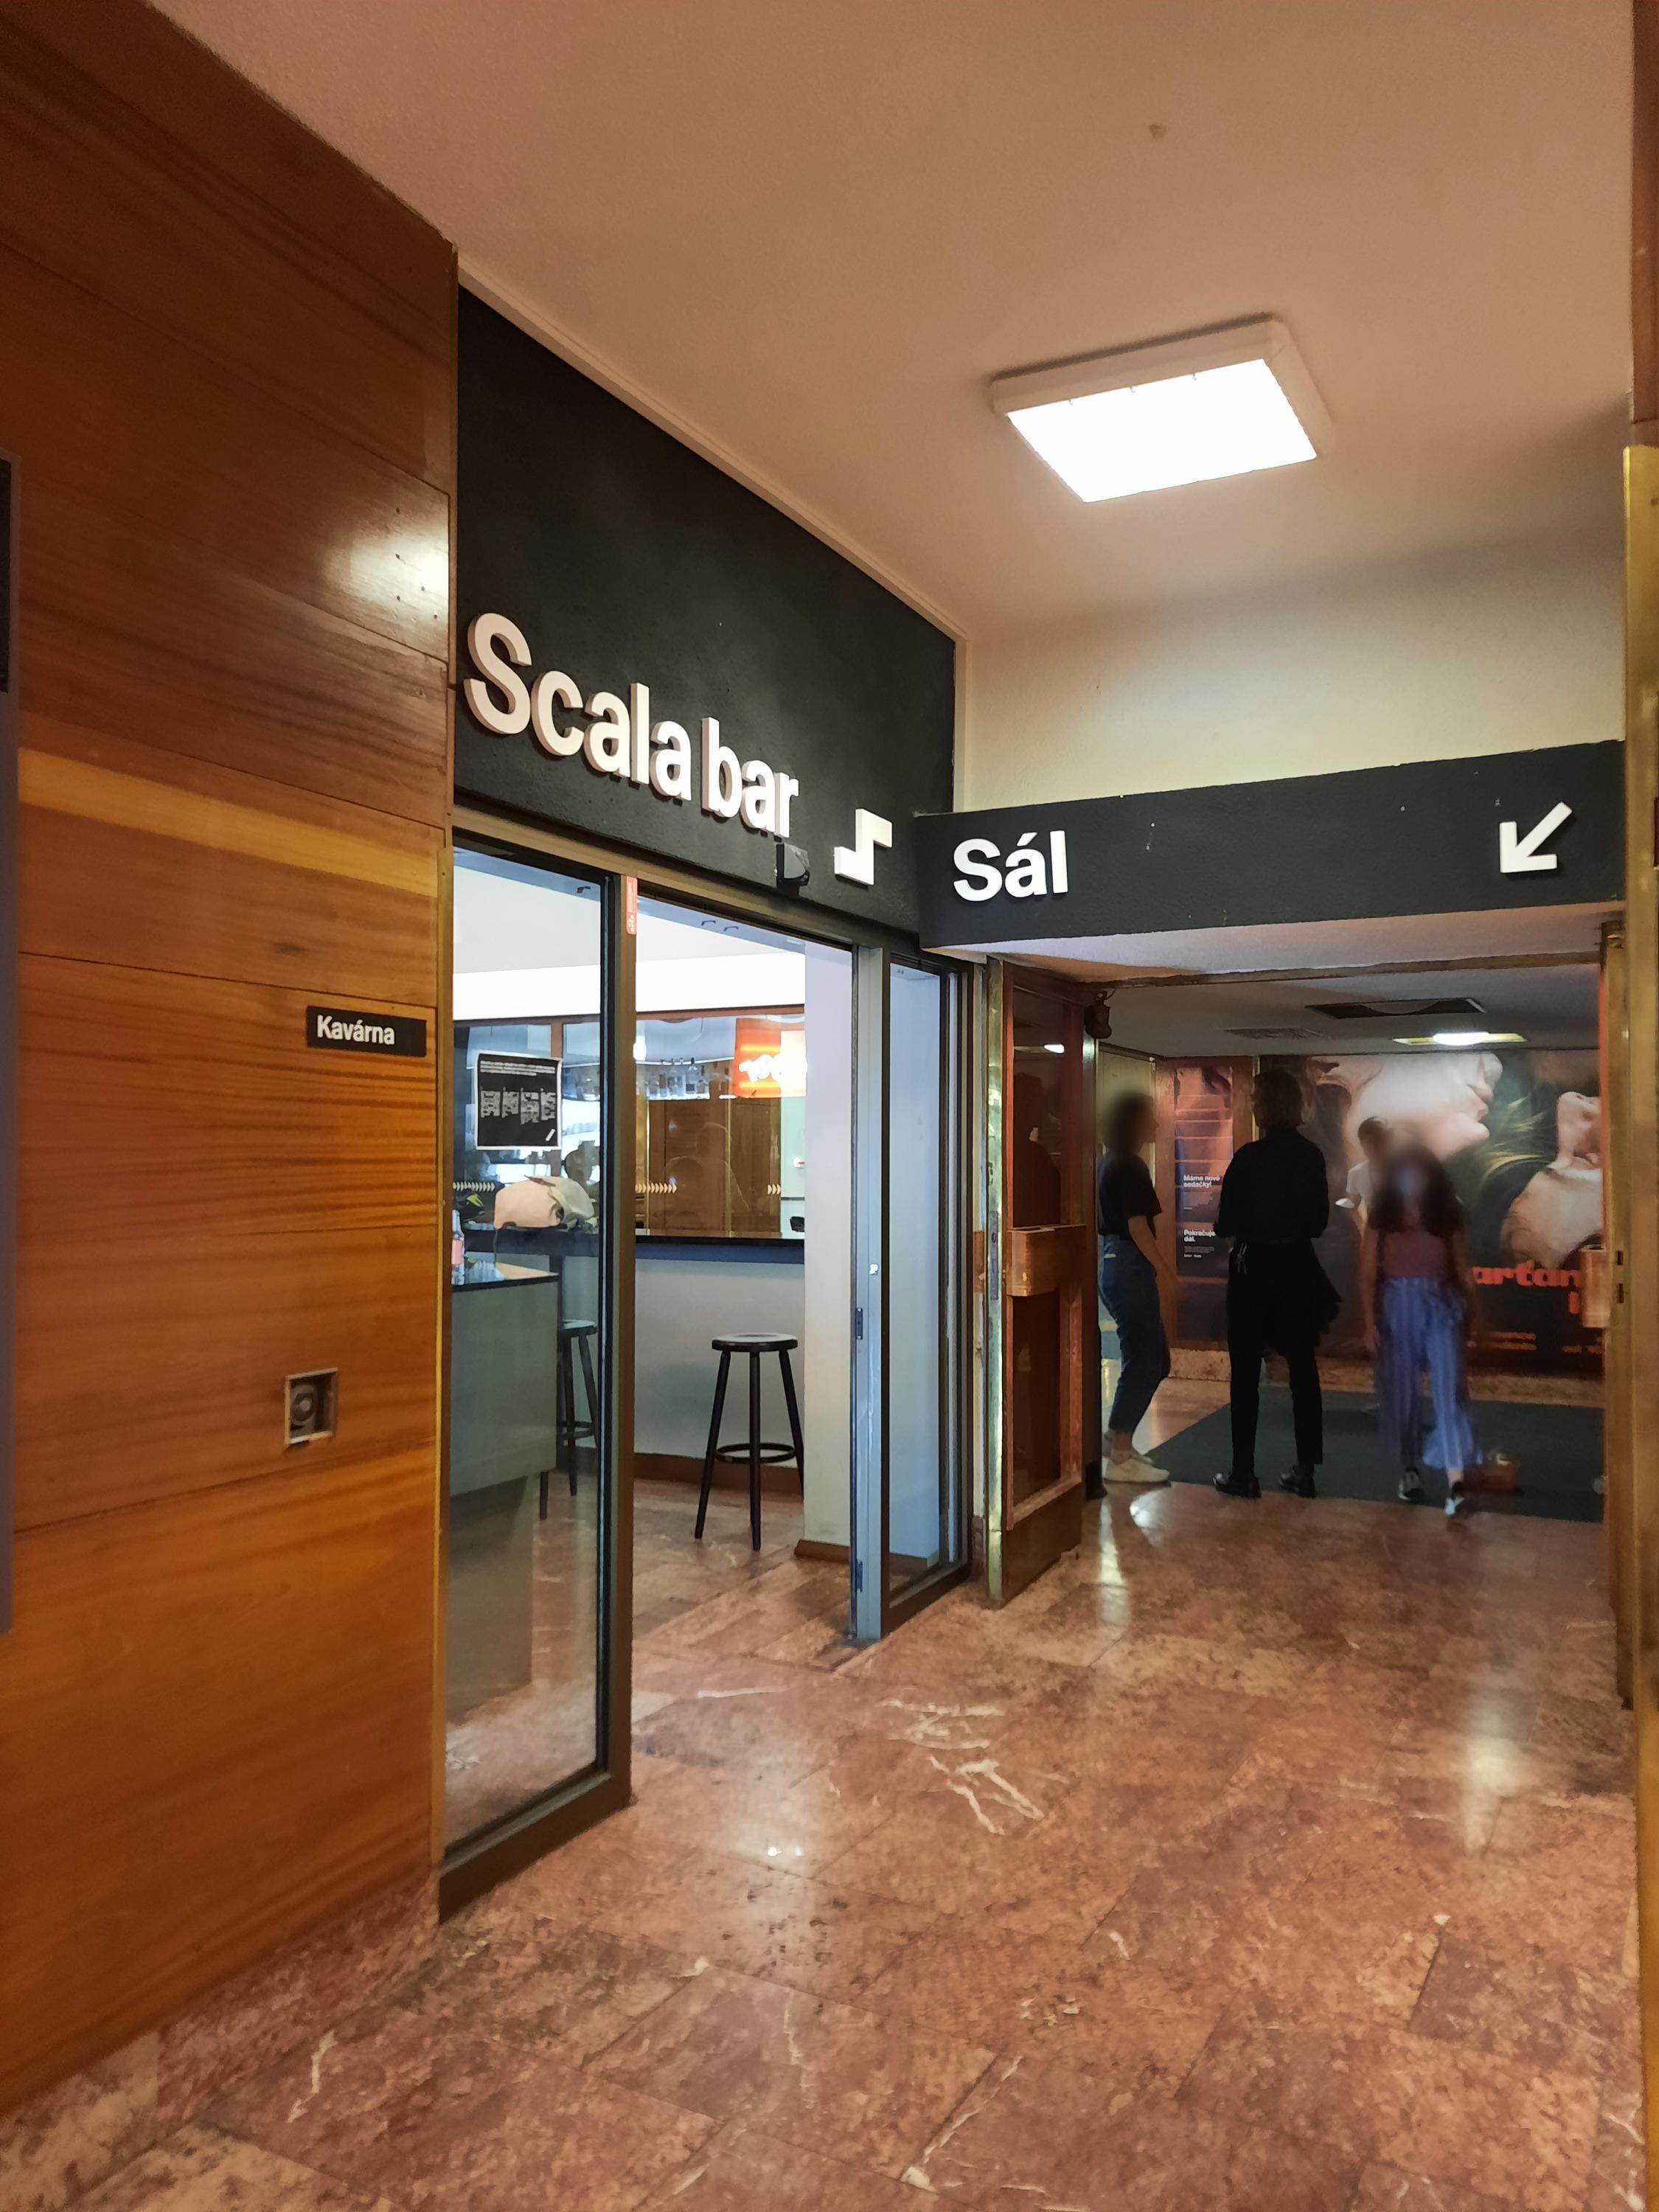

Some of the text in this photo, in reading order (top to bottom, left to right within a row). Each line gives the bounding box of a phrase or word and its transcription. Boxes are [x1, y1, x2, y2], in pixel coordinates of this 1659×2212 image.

[464, 613, 799, 838] Scala bar
[953, 830, 1069, 902] Sál
[317, 1015, 395, 1045] Kavárna
